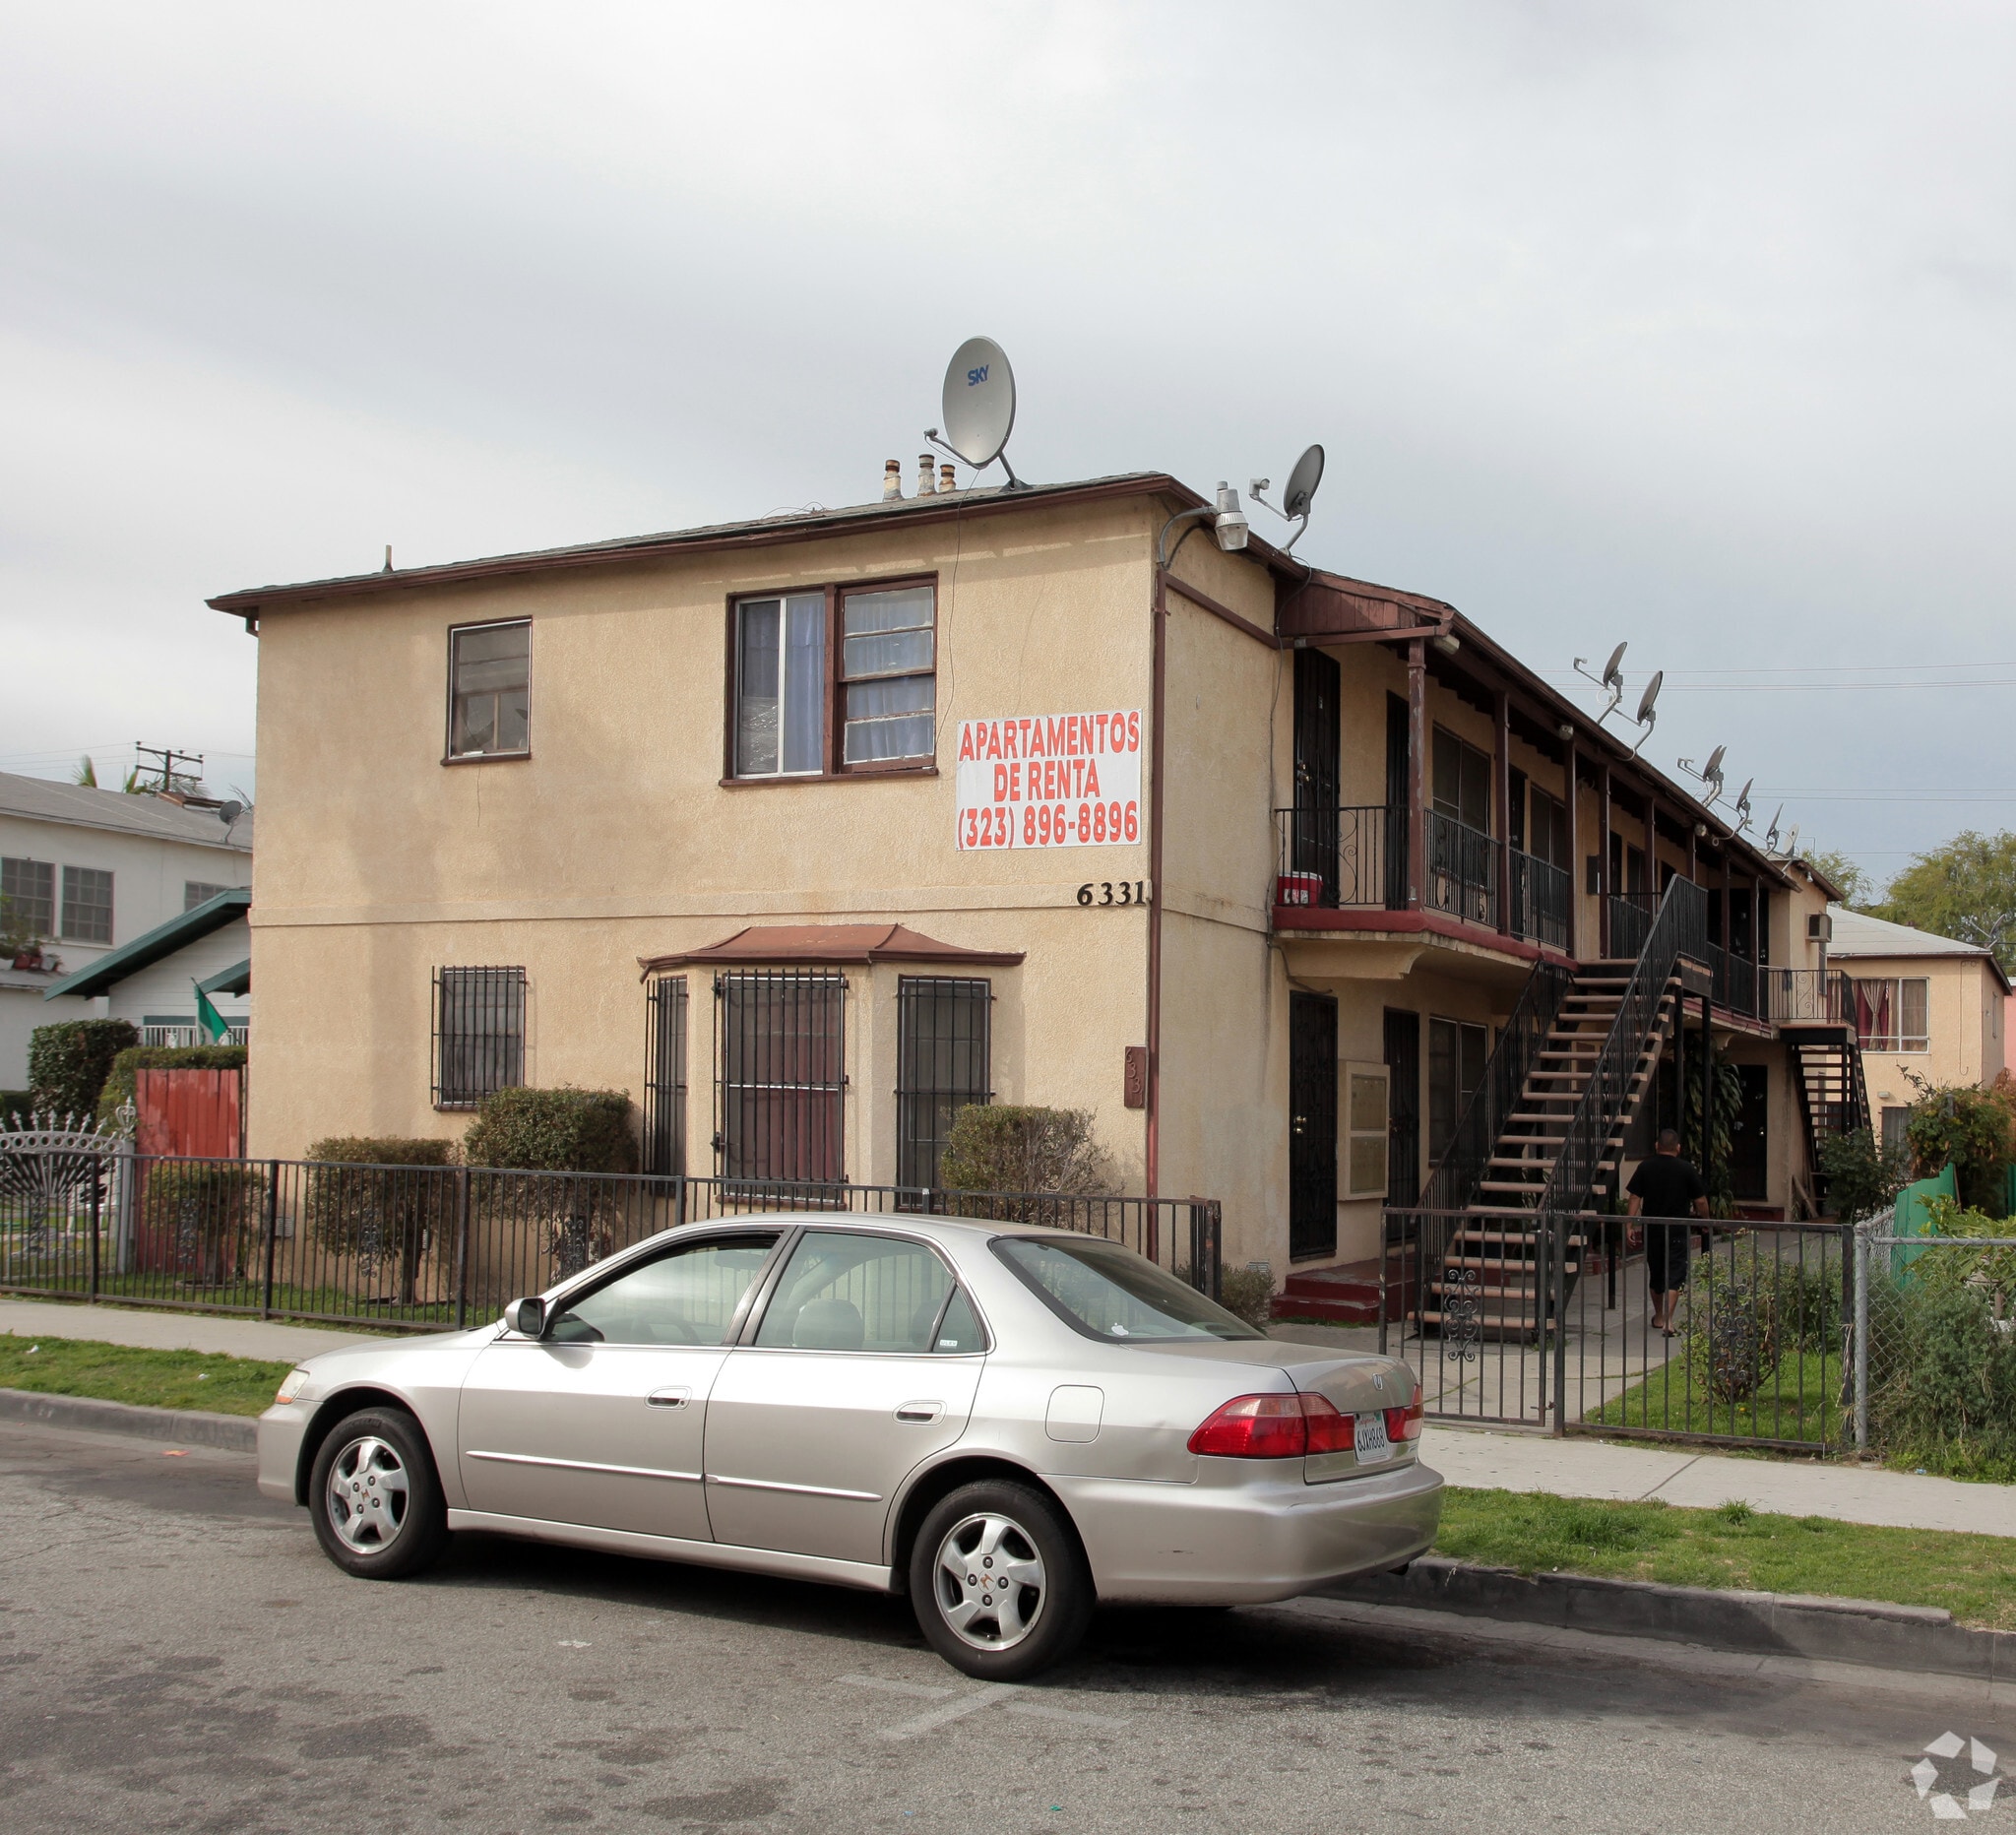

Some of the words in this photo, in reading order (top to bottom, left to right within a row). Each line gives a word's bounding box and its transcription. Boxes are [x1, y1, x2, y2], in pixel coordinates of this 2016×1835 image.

[968, 364, 988, 386] SKY
[959, 711, 1140, 761] APARTAMENTOS
[993, 762, 1021, 802] DE
[1028, 758, 1101, 800] RENTA
[958, 806, 1015, 849] (323)
[1023, 800, 1137, 846] 896-8896
[1077, 881, 1147, 906] 6331
